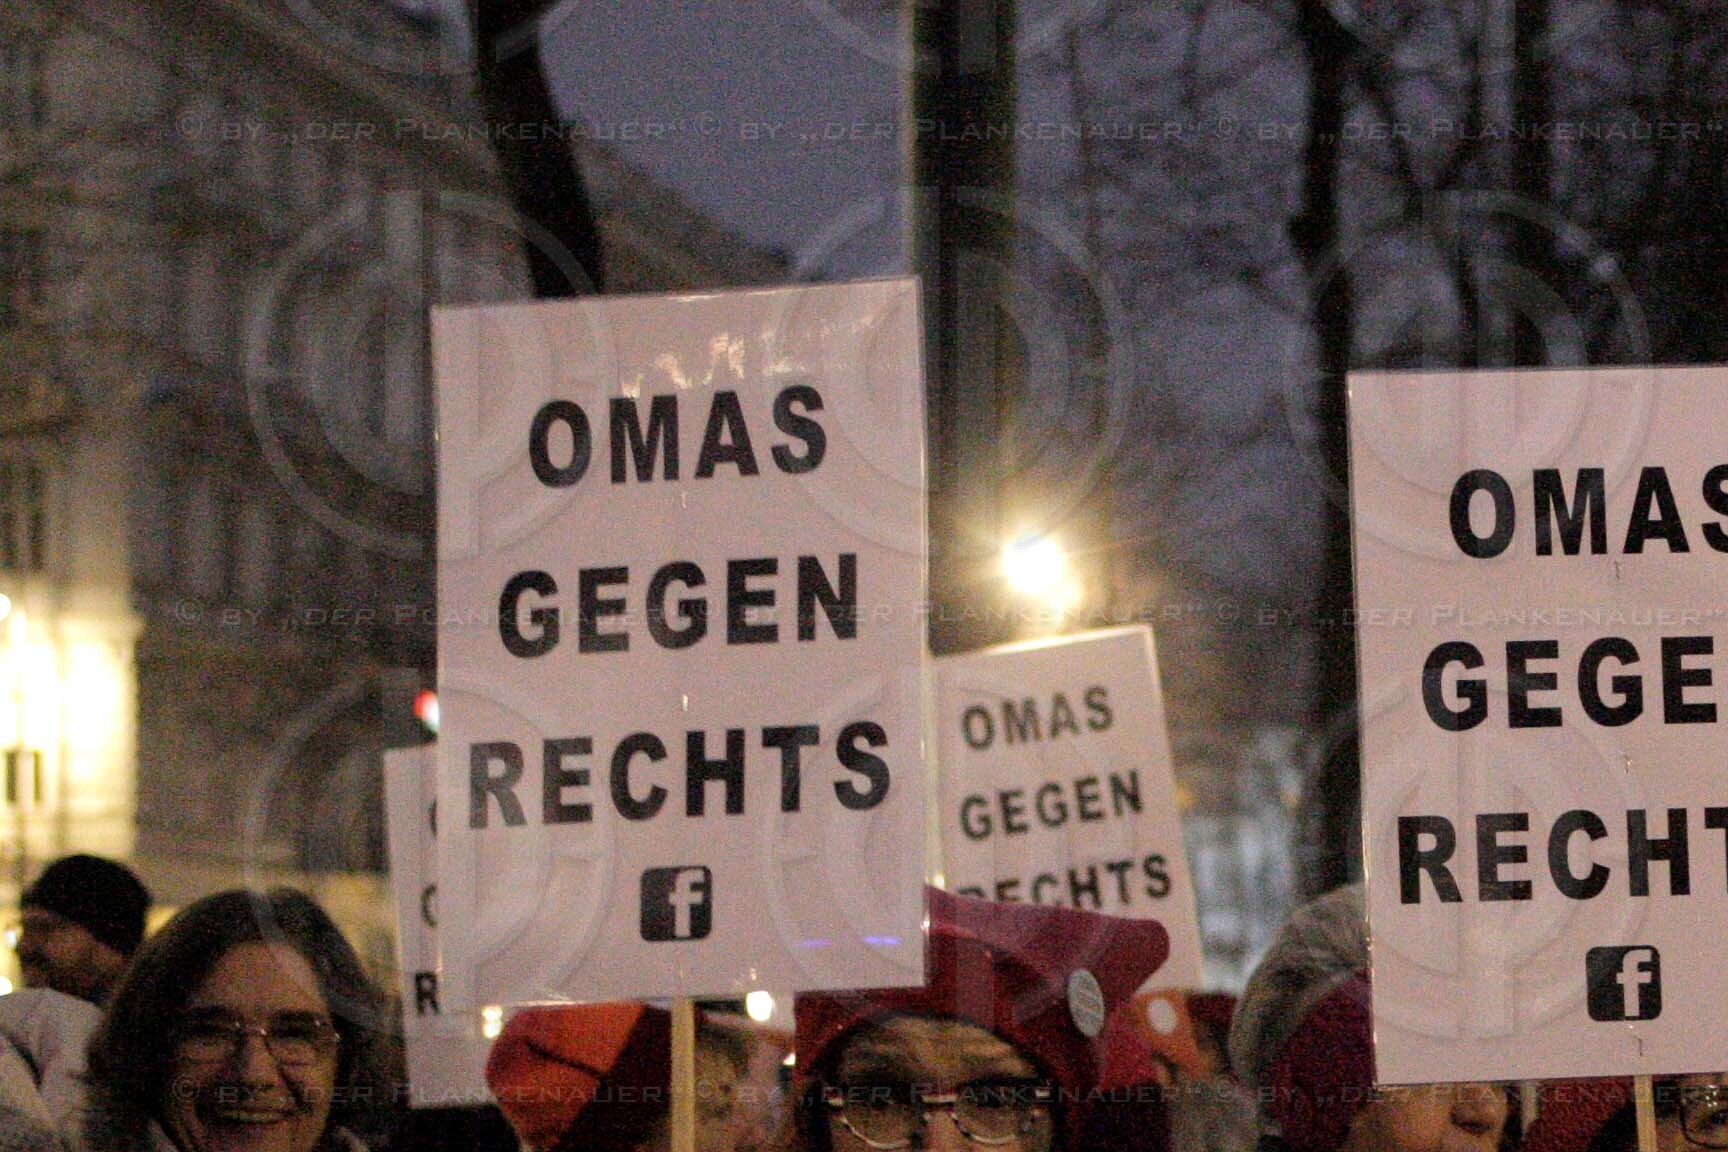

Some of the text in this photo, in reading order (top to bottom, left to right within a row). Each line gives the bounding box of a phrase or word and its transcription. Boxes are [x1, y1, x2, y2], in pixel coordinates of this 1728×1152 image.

[528, 385, 826, 487] OMAS
[498, 554, 856, 658] GEGEN
[961, 686, 1114, 751] OMAS
[470, 721, 890, 828] RECHTS
[959, 770, 1143, 841] GEGEN
